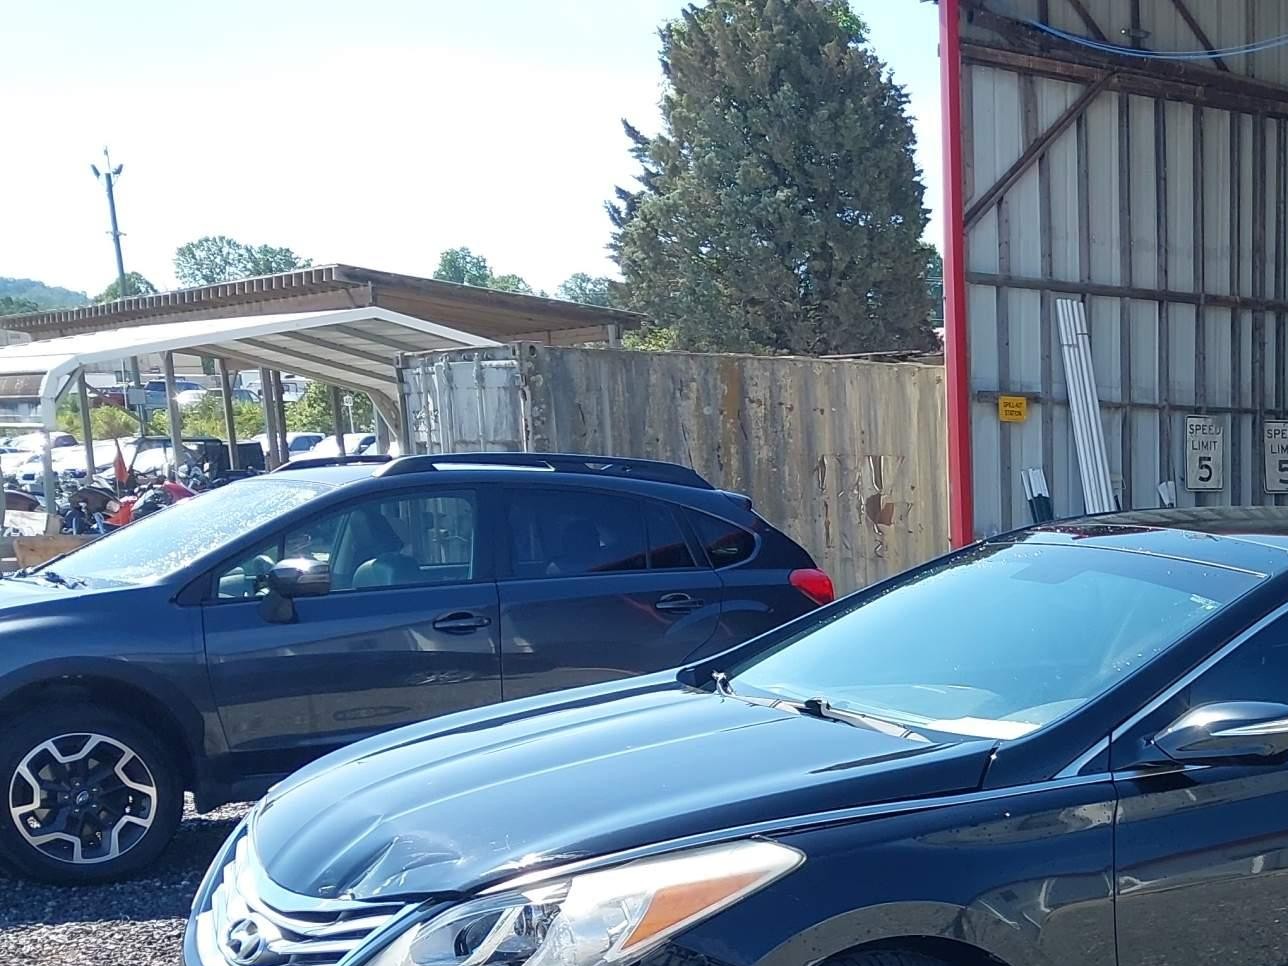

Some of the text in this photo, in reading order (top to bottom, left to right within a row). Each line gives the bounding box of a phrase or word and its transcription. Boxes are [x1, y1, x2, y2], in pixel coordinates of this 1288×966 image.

[1189, 424, 1221, 435] SPEED
[1191, 440, 1218, 451] LIMIT
[1198, 456, 1212, 482] 5
